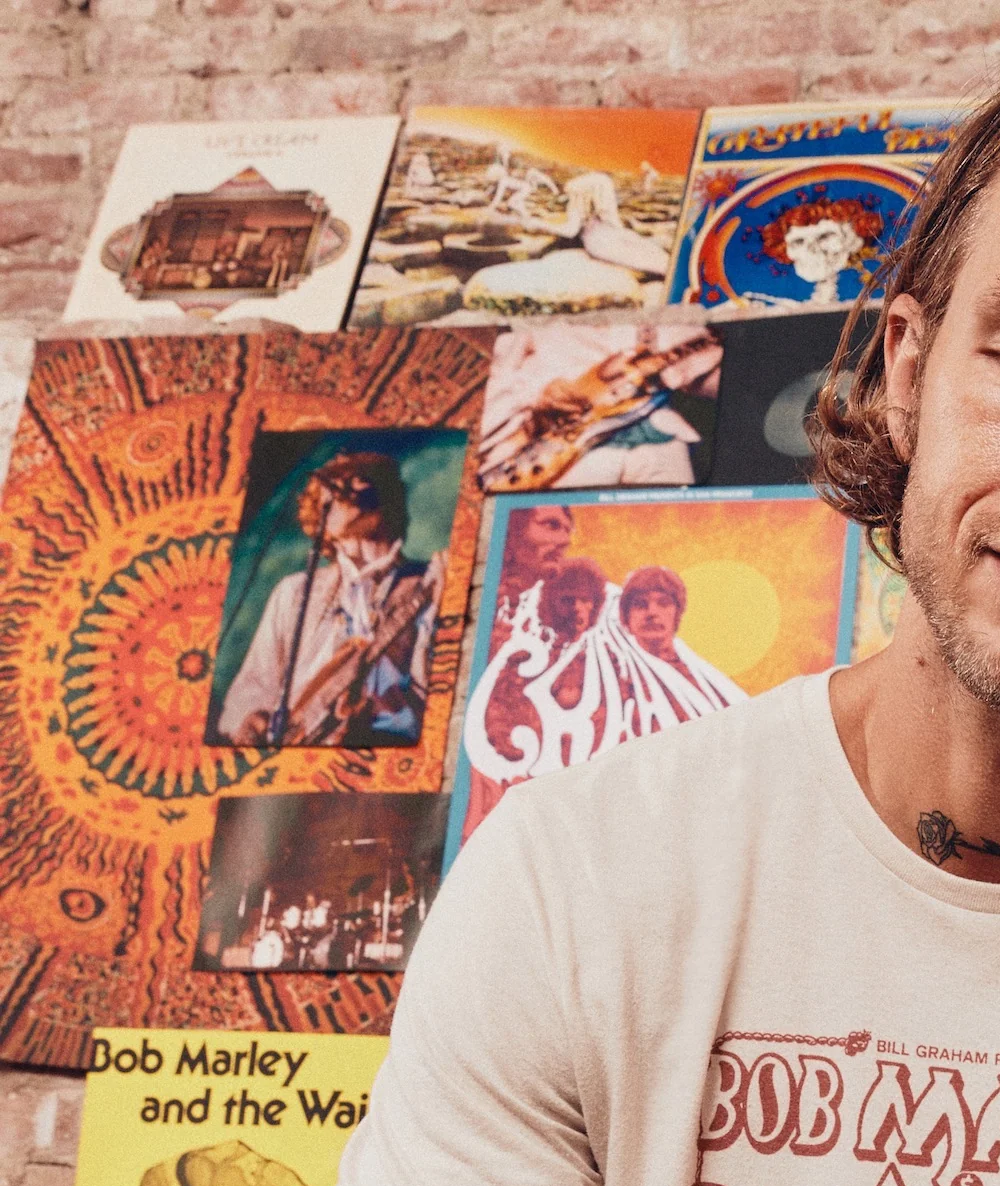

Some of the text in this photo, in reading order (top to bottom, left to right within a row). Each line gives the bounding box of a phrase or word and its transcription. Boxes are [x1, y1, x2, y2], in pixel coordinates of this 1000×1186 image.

[91, 1038, 309, 1088] Bob Marley
[877, 1040, 909, 1056] BILL
[915, 1045, 988, 1065] GRAHAM
[140, 1088, 211, 1124] and
[224, 1089, 287, 1125] the
[697, 1050, 845, 1157] BOB
